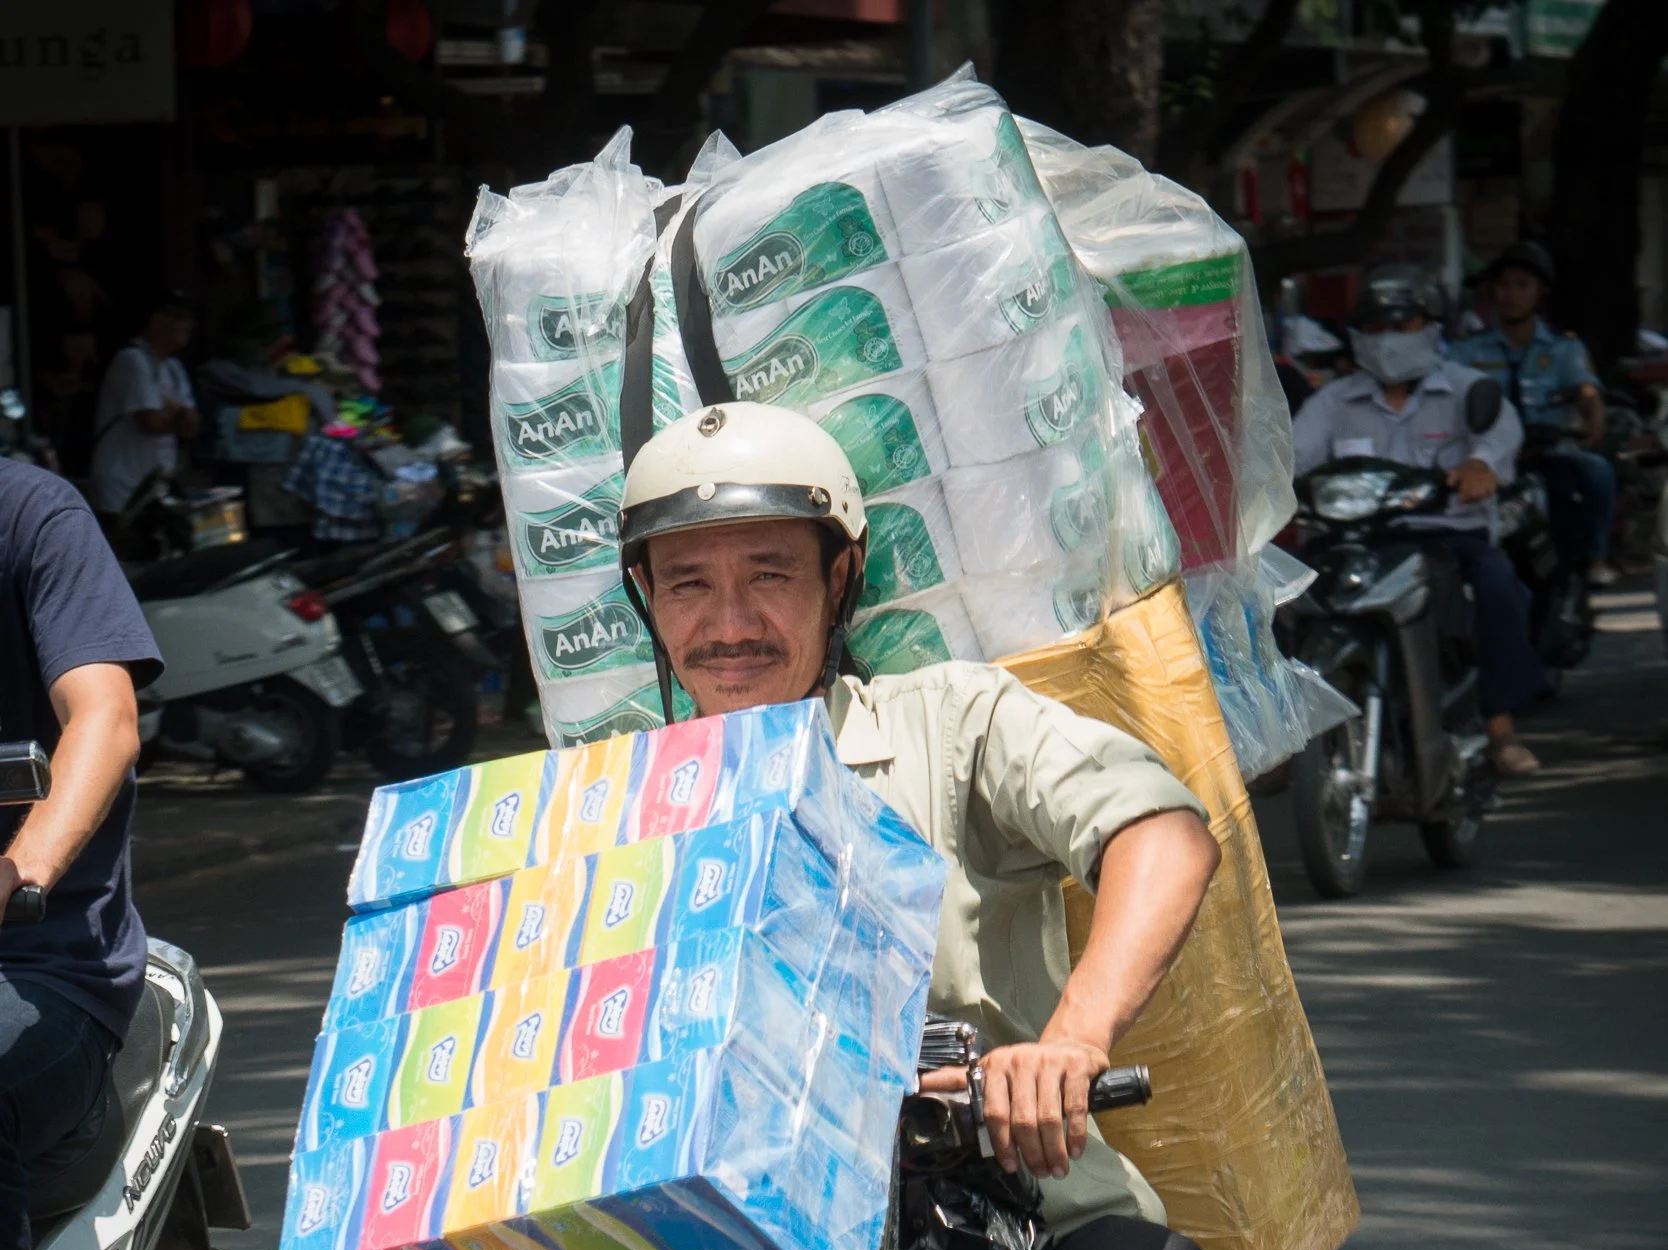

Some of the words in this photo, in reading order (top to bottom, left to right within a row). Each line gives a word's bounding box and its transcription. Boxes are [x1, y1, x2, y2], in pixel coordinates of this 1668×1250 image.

[727, 251, 793, 297] AnAn
[737, 354, 805, 400] AnAn
[518, 410, 593, 445] AnAn
[541, 517, 616, 553] AnAn
[556, 620, 628, 658] AnAn
[123, 1112, 176, 1215] NOUVO
